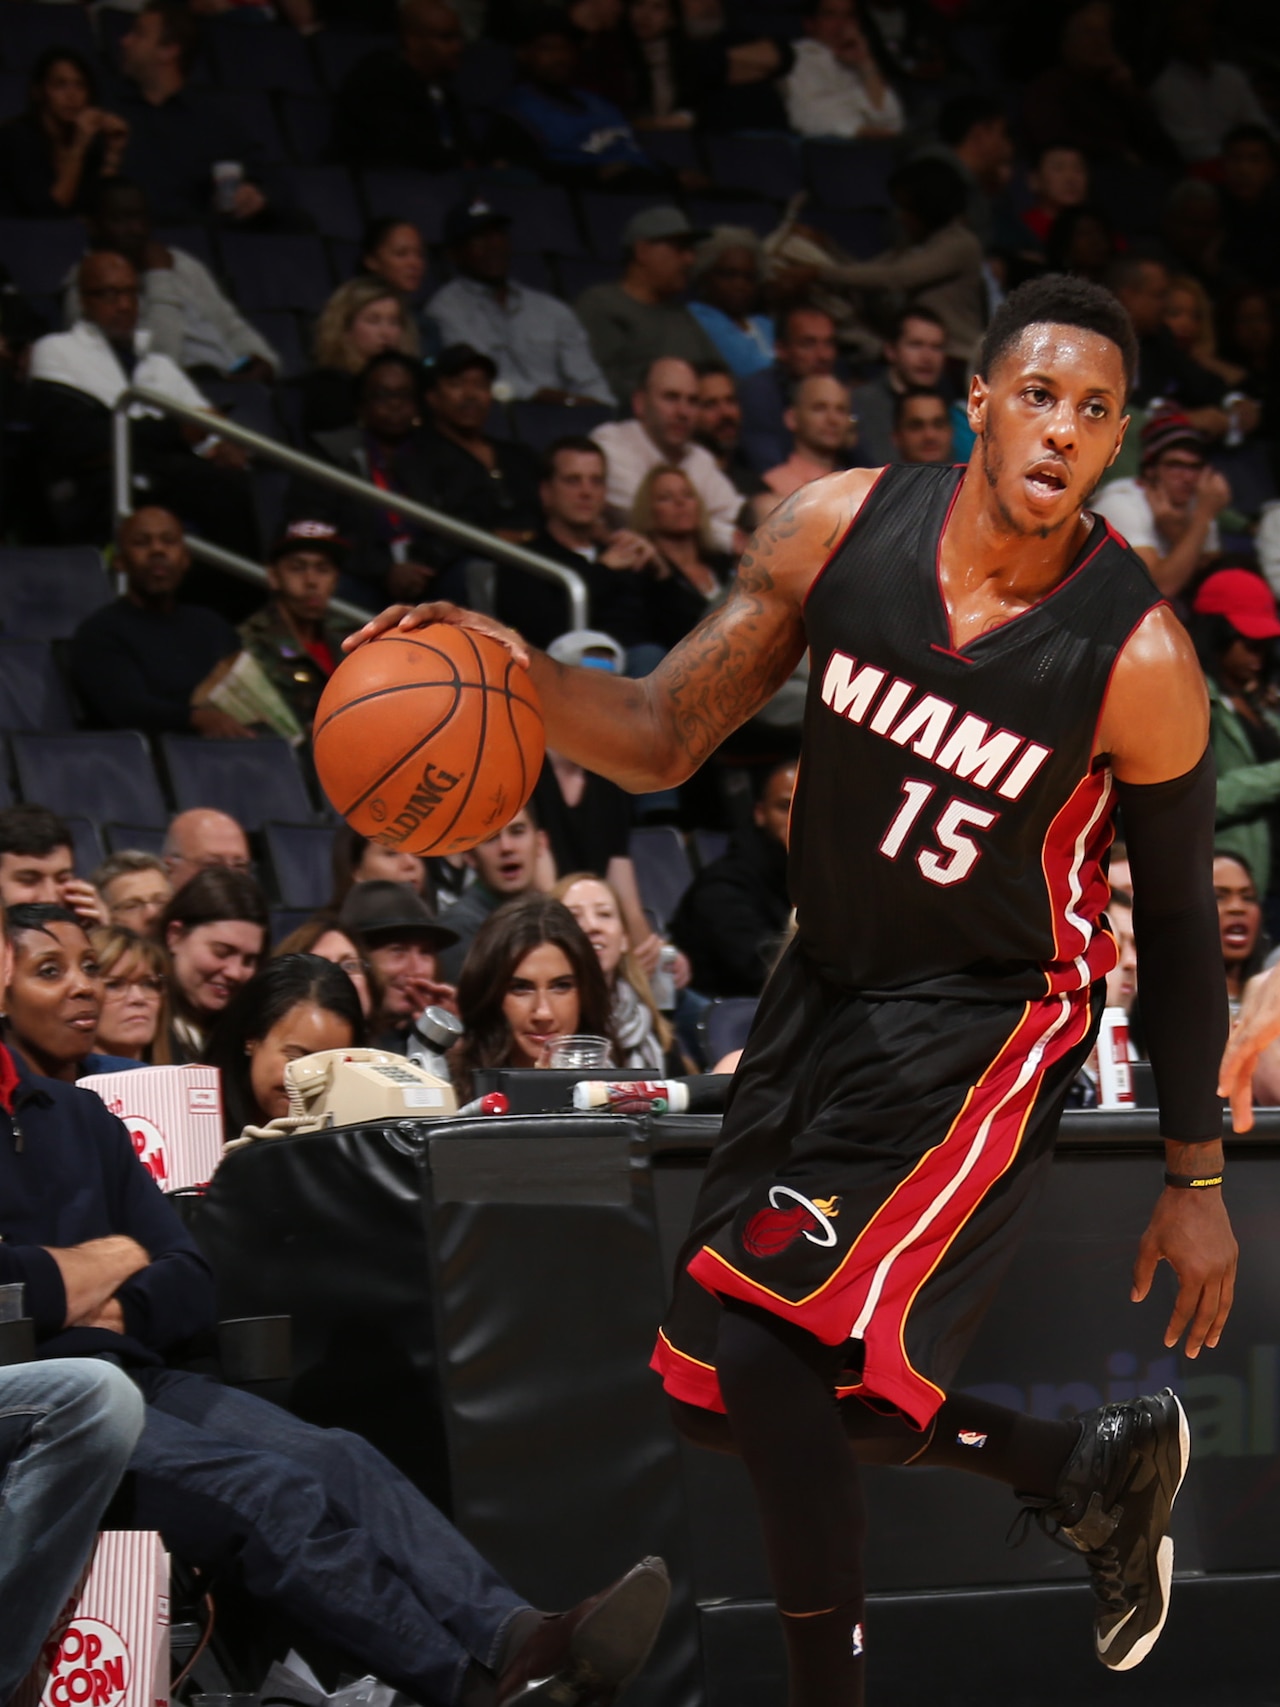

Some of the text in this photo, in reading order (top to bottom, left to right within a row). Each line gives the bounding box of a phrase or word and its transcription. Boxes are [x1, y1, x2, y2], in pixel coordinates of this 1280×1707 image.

[821, 649, 1053, 802] MIAMI
[366, 762, 462, 846] ALDING
[876, 777, 1001, 887] 15
[51, 1656, 124, 1707] CORN
